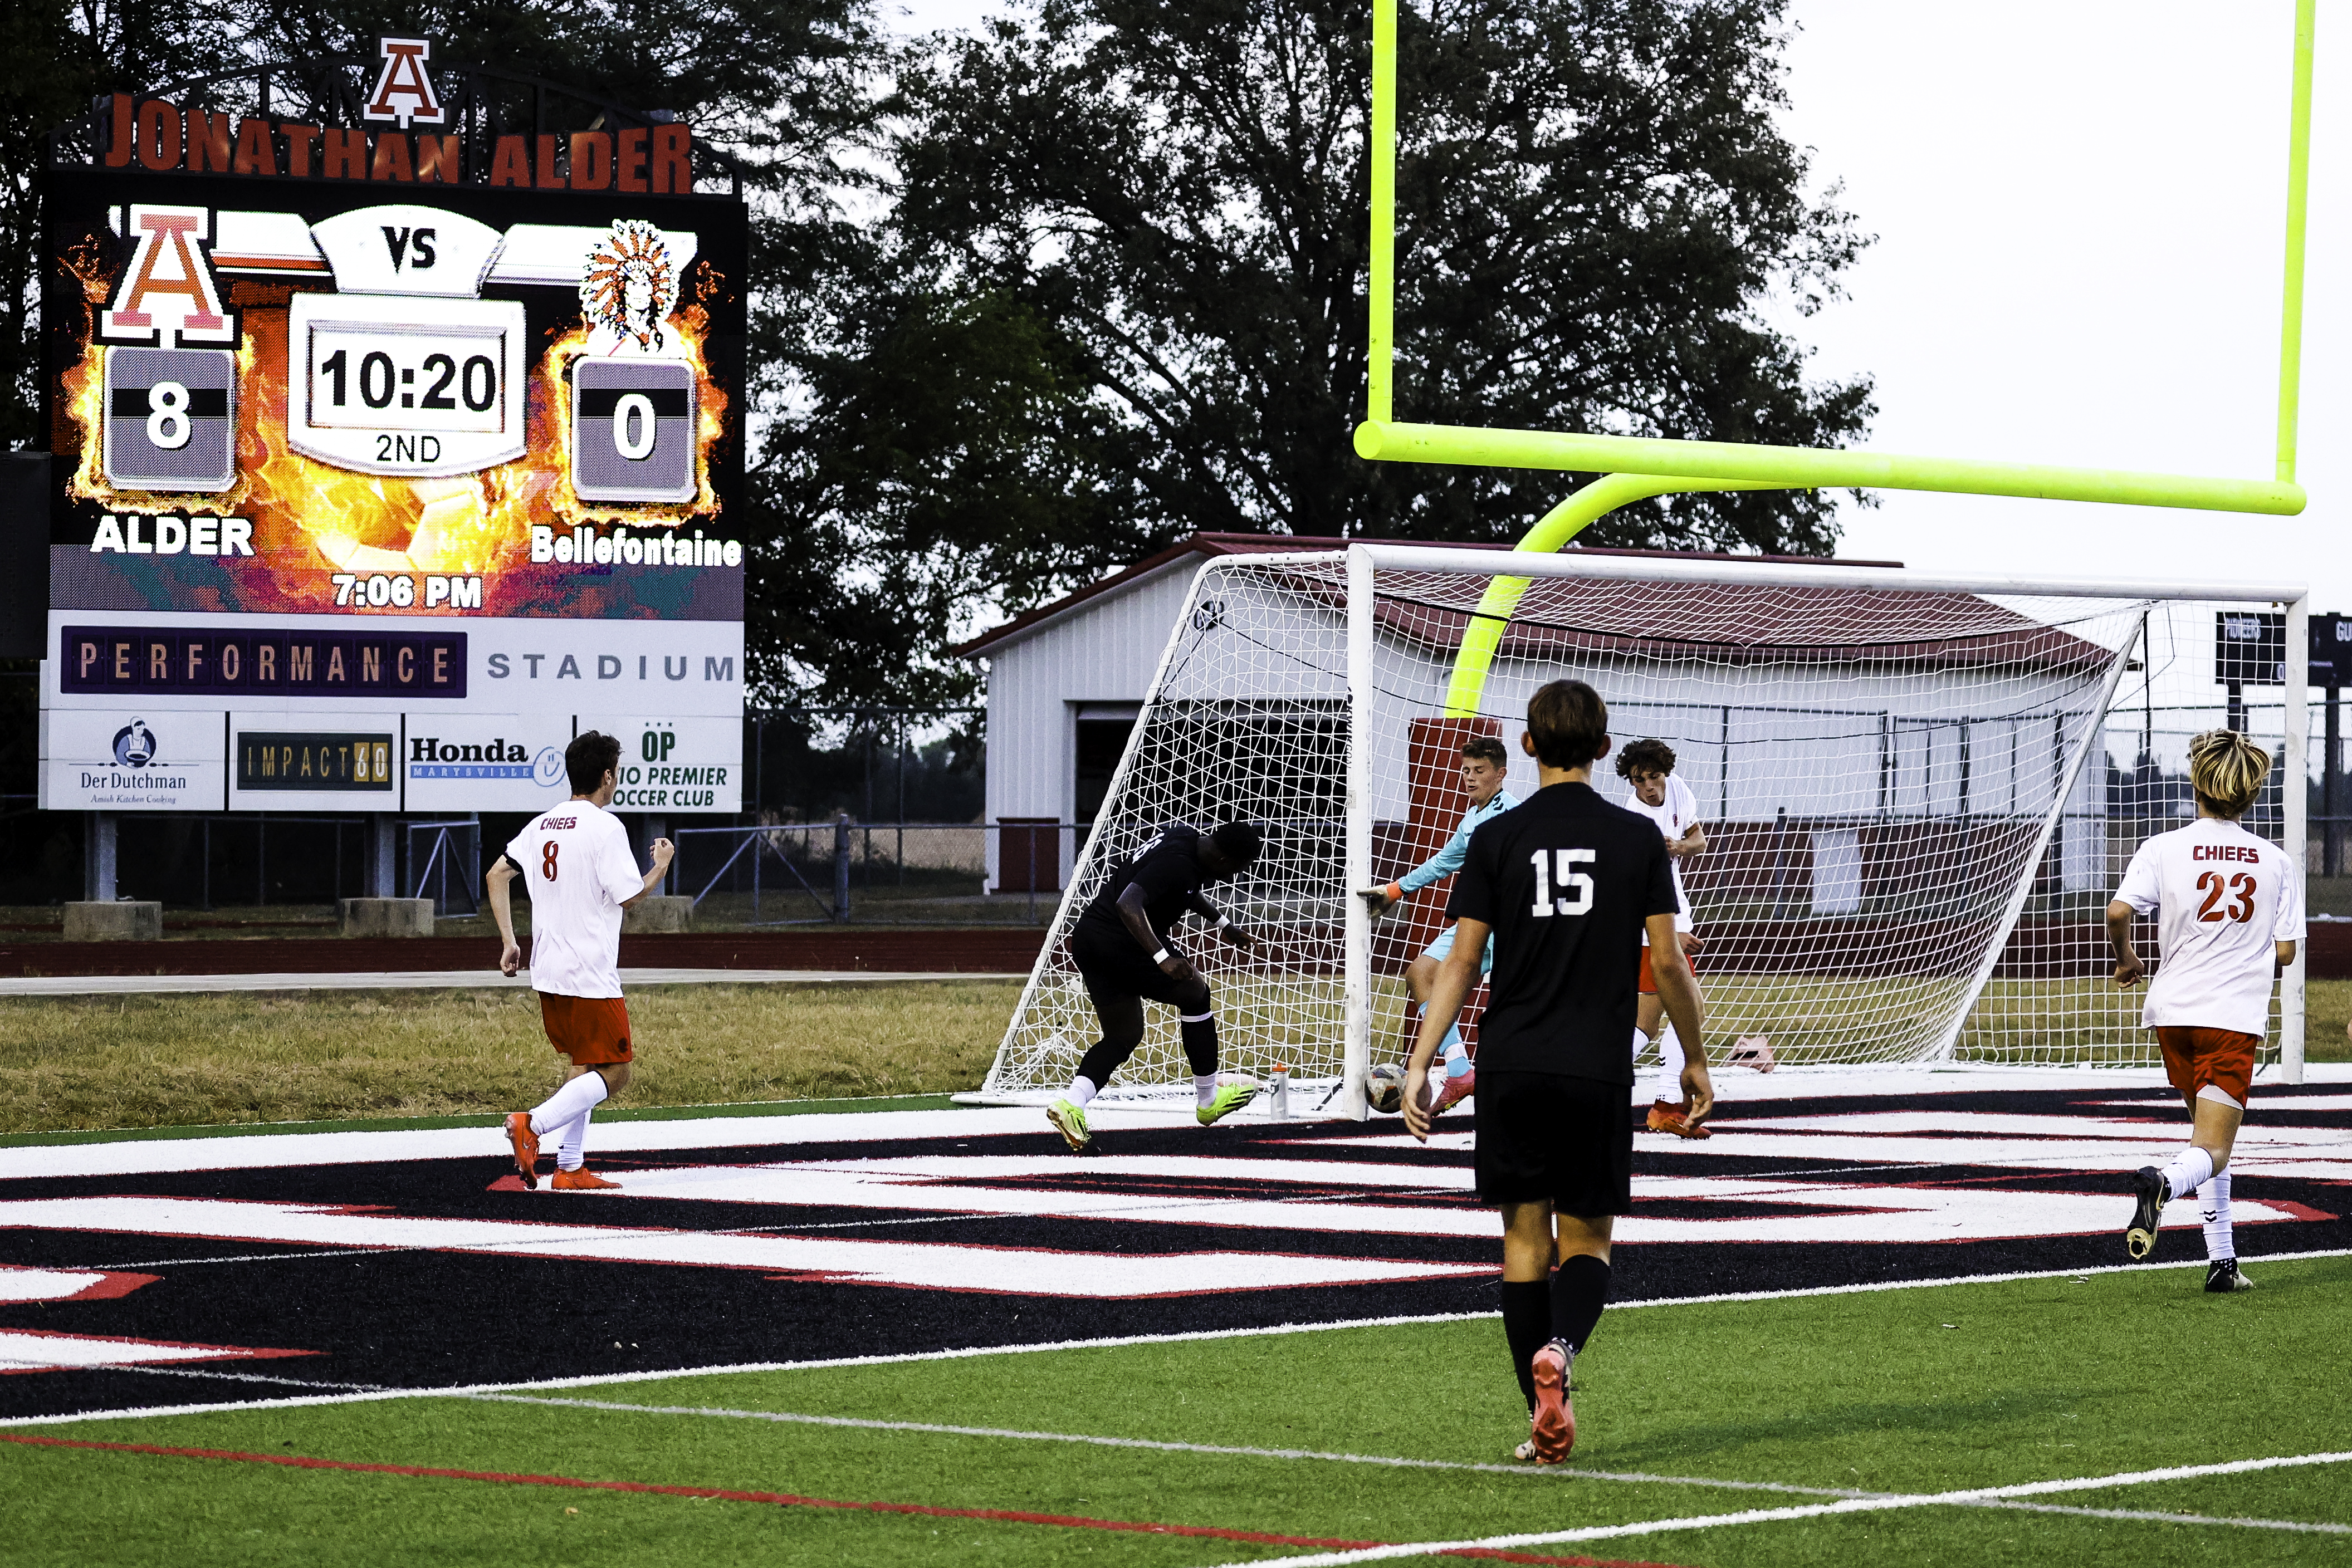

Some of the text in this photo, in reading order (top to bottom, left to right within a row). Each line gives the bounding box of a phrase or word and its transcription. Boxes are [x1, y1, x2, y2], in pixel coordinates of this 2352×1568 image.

[105, 92, 692, 194] JONATHAN ALDER
[379, 226, 436, 276] VS
[321, 349, 496, 412] 10:20
[146, 381, 192, 449] 8
[613, 393, 657, 460] 0
[376, 434, 441, 463] 2ND
[90, 514, 255, 556] ALDER
[531, 525, 742, 567] Bellefontaine
[332, 574, 482, 609] 7:06 PM
[80, 643, 734, 683] PERFORMANCE STADIUM
[410, 738, 529, 762] Honda
[642, 731, 675, 762] OP
[81, 772, 187, 788] Der Dutchman
[413, 766, 529, 777] MARYSVILLE
[647, 767, 727, 786] PREMIER
[116, 794, 144, 803] Kitchen
[613, 790, 714, 806] OCCER CLUB
[539, 816, 578, 830] CHIEFS
[542, 840, 559, 882] 8
[2193, 845, 2260, 864] CHIEFS
[1530, 848, 1596, 917] 15
[2196, 871, 2257, 923] 23
